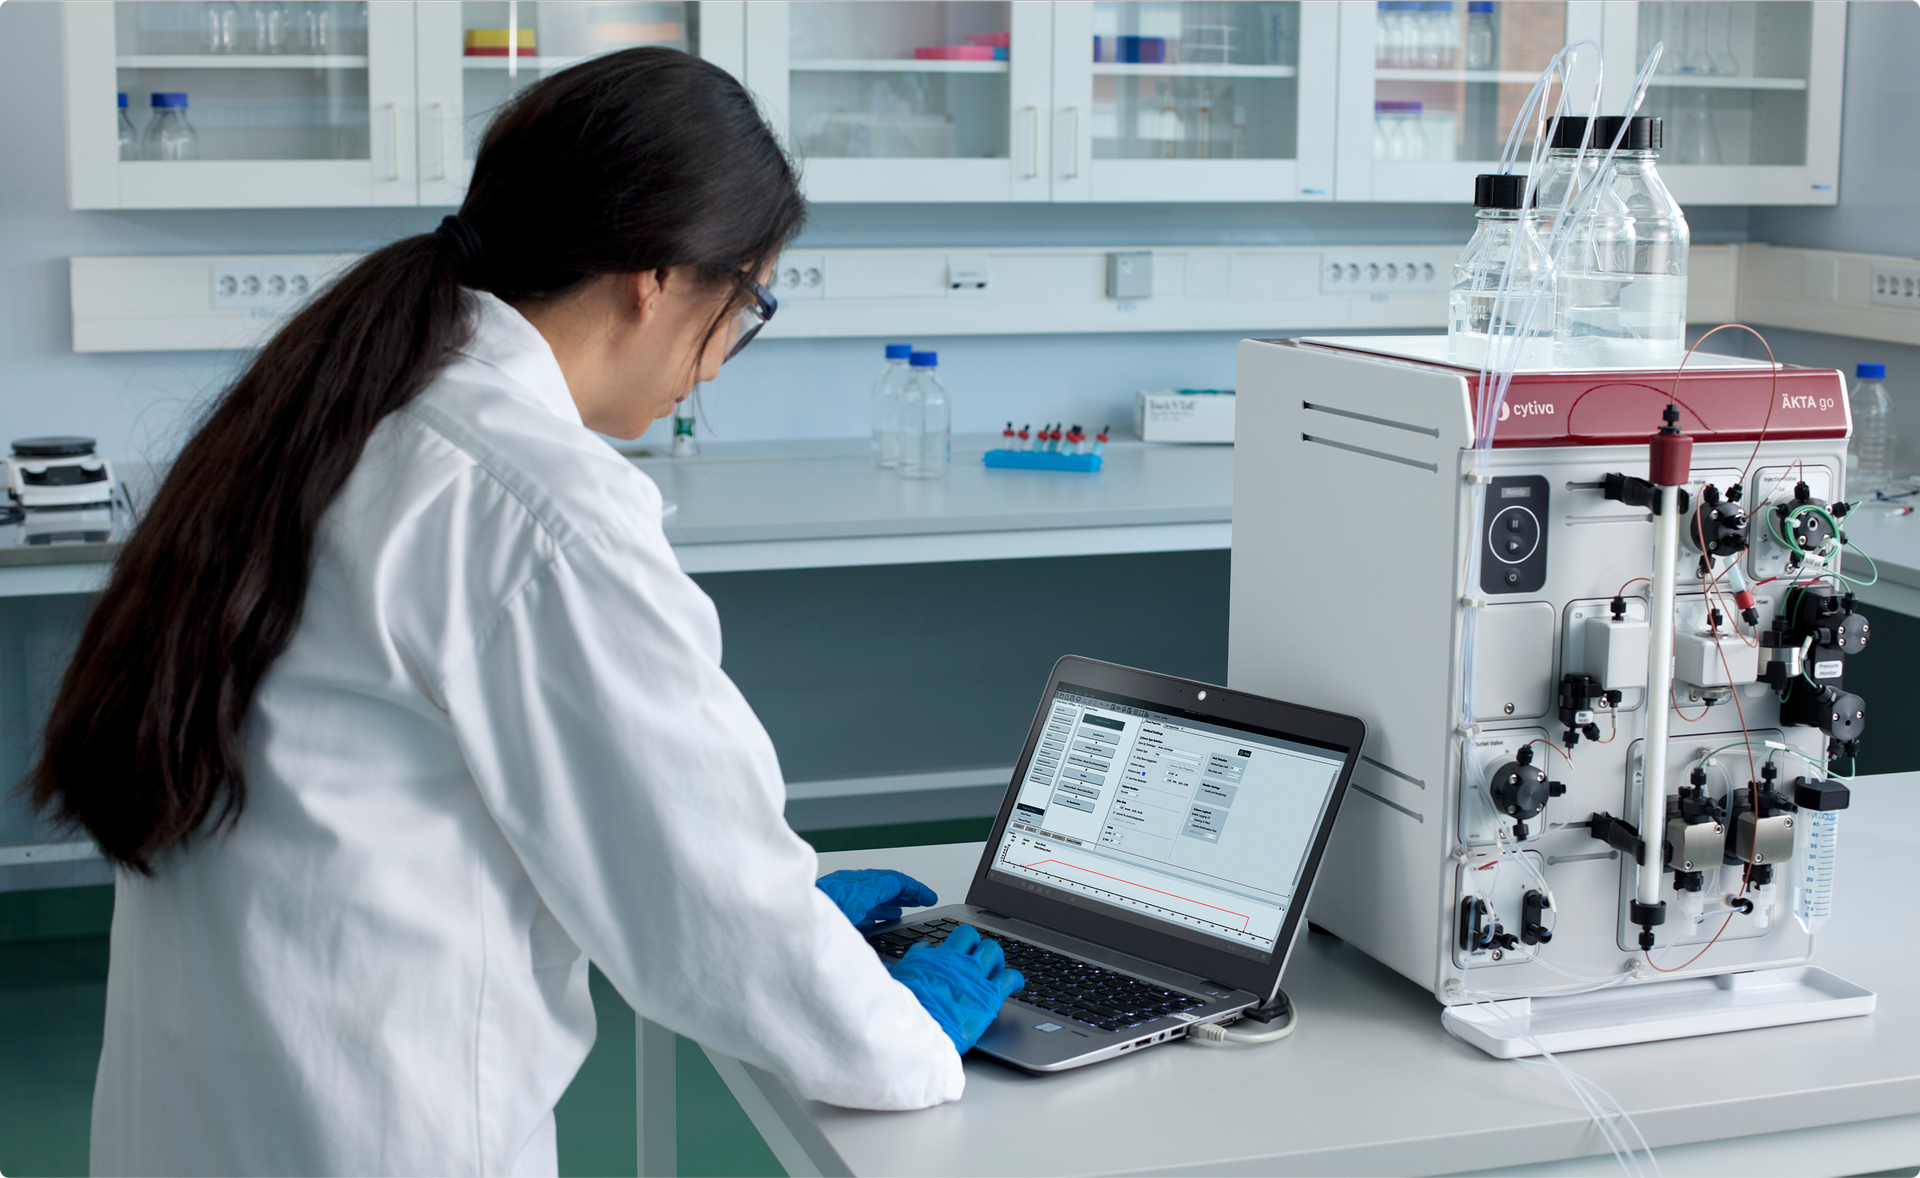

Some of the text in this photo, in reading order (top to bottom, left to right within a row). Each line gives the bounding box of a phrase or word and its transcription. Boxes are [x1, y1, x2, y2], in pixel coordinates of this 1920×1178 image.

[1513, 400, 1555, 418] cytiva
[1782, 393, 1834, 411] ÄKTA go
[1506, 487, 1527, 496] Ready
